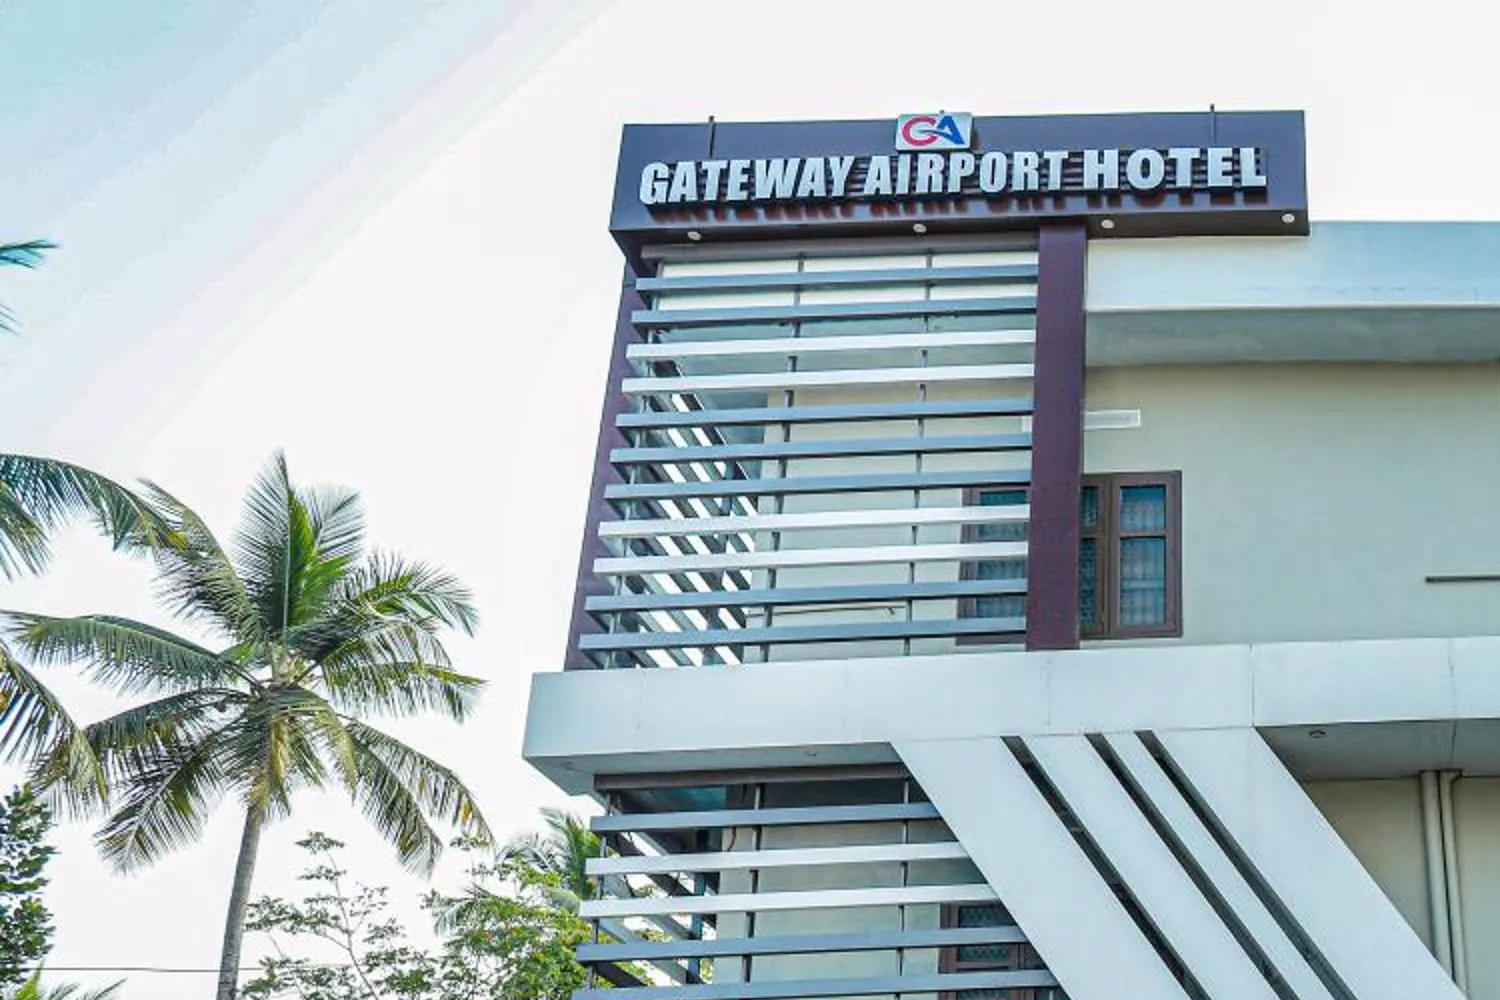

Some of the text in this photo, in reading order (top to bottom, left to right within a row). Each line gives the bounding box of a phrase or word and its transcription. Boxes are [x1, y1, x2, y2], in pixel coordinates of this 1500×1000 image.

[639, 147, 1267, 206] GATEWAY AIRPORT HOTEL
